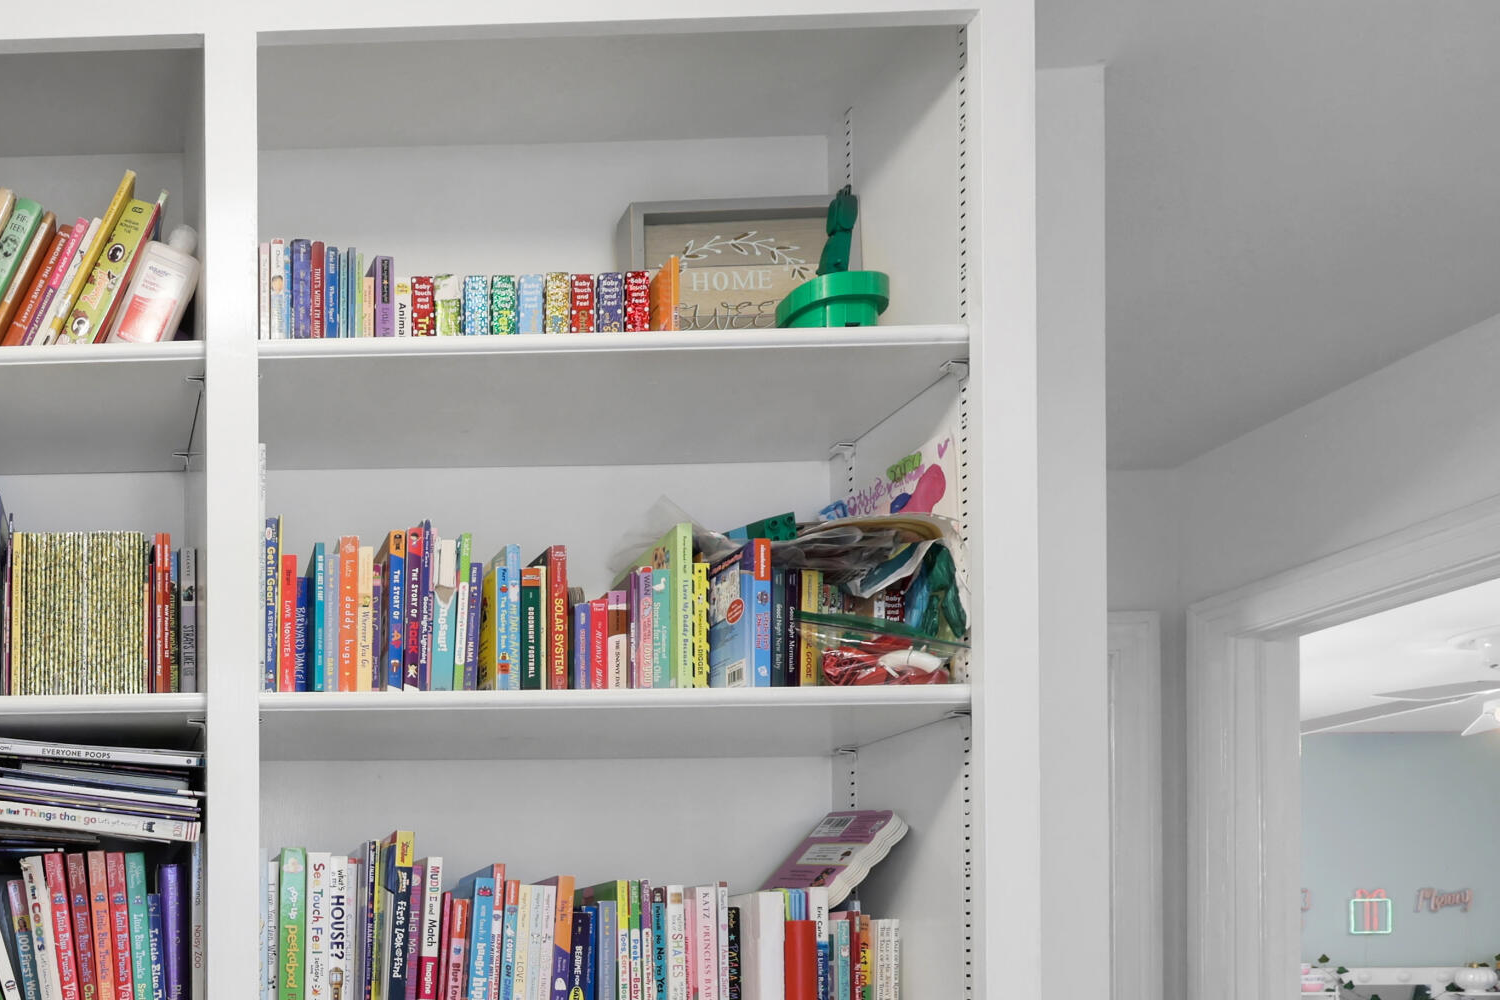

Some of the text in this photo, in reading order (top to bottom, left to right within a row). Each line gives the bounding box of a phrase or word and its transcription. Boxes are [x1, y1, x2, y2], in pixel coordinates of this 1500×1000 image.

[692, 269, 772, 292] HOME
[267, 547, 276, 565] Get
[266, 567, 275, 576] in
[266, 579, 275, 606] Gear!
[392, 586, 400, 608] STORY
[392, 611, 399, 619] OF
[408, 567, 419, 654] THE STORY OF ROCK
[342, 596, 354, 664] daddy hugs
[554, 598, 564, 675] SOLAR SYSTEM
[183, 625, 194, 664] STRAYS LIKE
[294, 607, 306, 683] BARNYARD DANCE!
[41, 748, 111, 760] EVERYONE POOPS
[429, 866, 440, 902] MUDDLE
[287, 886, 298, 920] pop-up
[702, 893, 710, 919] KATZ
[56, 910, 69, 931] Little
[330, 895, 345, 959] HOUSE?
[427, 919, 437, 947] Match
[18, 934, 30, 952] 100
[59, 933, 71, 949] Blue
[150, 928, 160, 960] Little
[194, 924, 202, 968] Noisy Zoo
[656, 935, 661, 944] No
[703, 925, 711, 974] PRINCESS
[20, 953, 34, 978] First
[60, 950, 74, 981] Truck's
[283, 925, 300, 988] peekaboo!
[656, 947, 664, 960] No
[672, 934, 683, 977] SHAPES
[151, 963, 162, 987] Blue
[423, 962, 434, 994] Imagine
[451, 962, 461, 982] Blue
[631, 939, 641, 999] Peek-a-Baby
[657, 977, 665, 993] Yes
